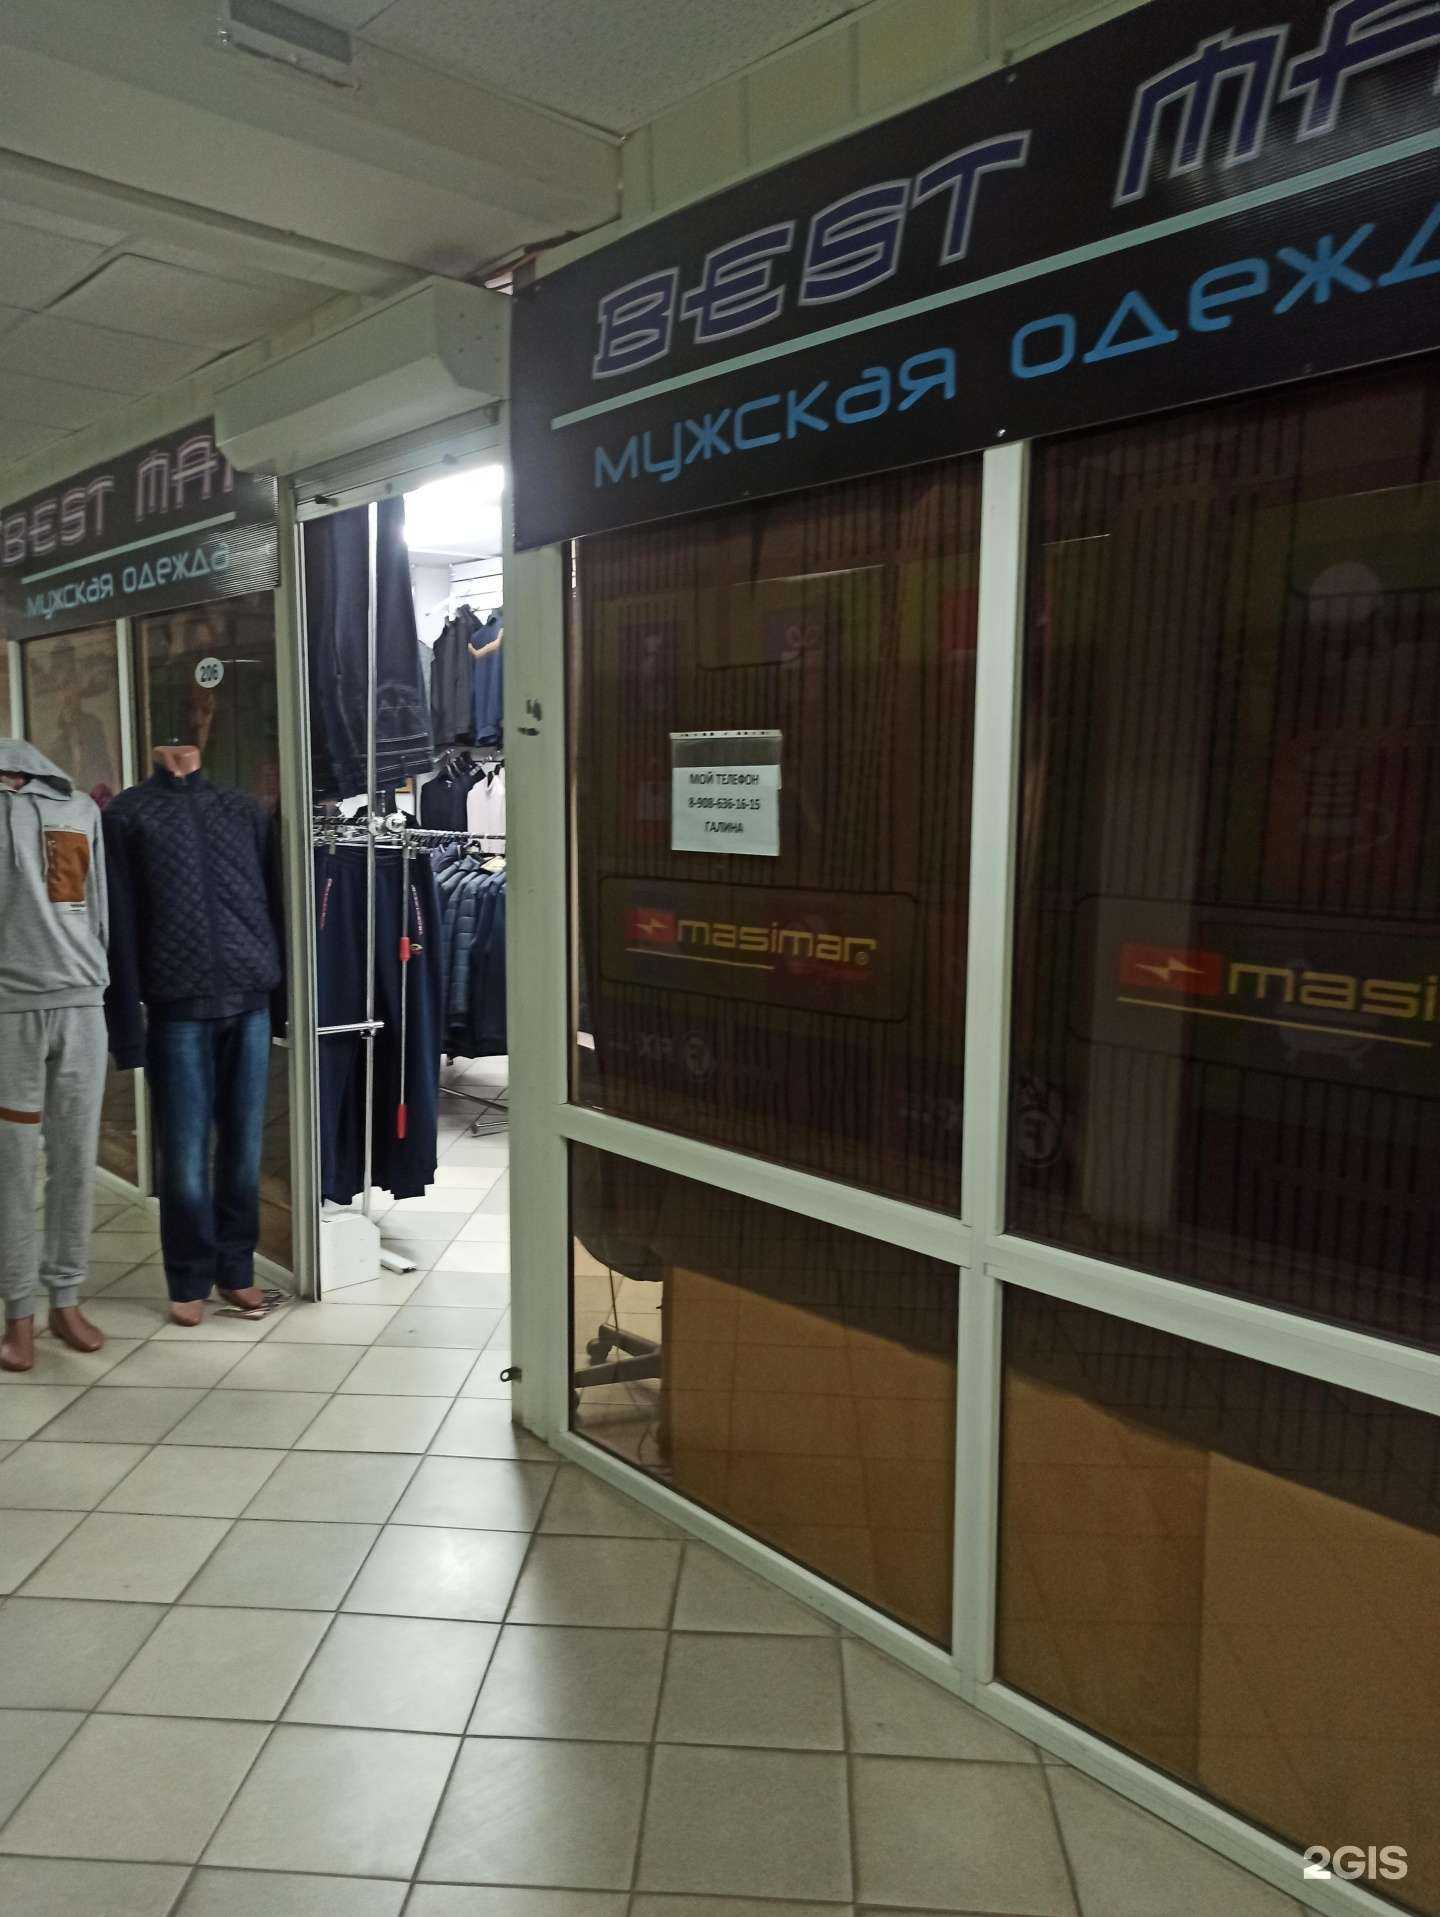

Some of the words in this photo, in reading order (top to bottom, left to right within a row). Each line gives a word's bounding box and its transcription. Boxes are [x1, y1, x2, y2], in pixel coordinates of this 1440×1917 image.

[592, 129, 1032, 381] BEST
[0, 475, 115, 568] BEST
[689, 771, 714, 785] МОЙ
[715, 773, 760, 786] ТЕЛЕФОН
[703, 820, 744, 834] ГАЛИНА
[676, 918, 877, 964] masimar
